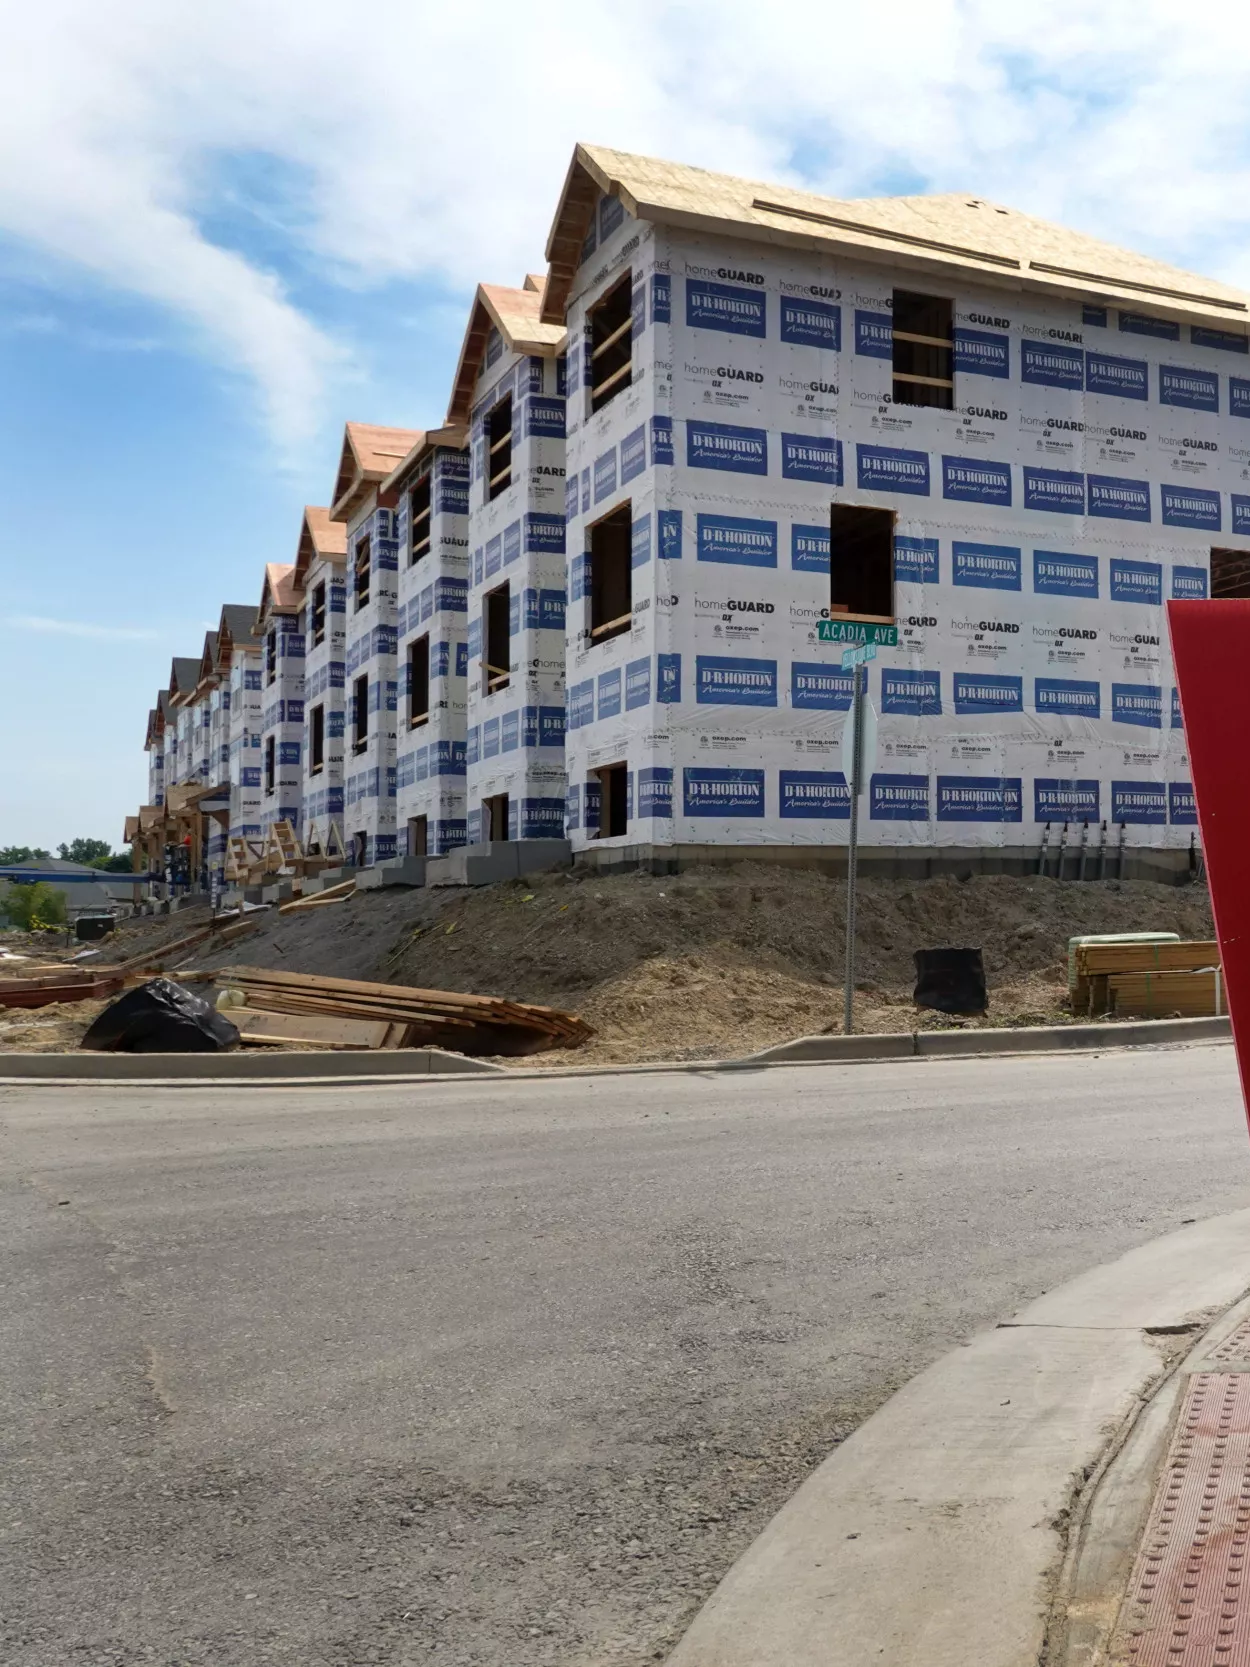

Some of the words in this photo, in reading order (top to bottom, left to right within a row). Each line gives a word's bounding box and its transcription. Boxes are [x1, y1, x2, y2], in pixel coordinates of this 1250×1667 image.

[685, 262, 764, 285] homeGUARD
[684, 362, 764, 383] homeGUARD
[1020, 414, 1084, 432] homeGUARD
[1084, 424, 1146, 441] homeGUARD
[1158, 435, 1217, 451] homeGUARD
[695, 598, 775, 613] homeGUARD
[725, 625, 759, 633] oxep.com
[823, 623, 867, 642] ACADIA
[874, 628, 894, 644] AVE
[952, 620, 1020, 634] homeGUARD
[1033, 626, 1097, 640] homeGUARD
